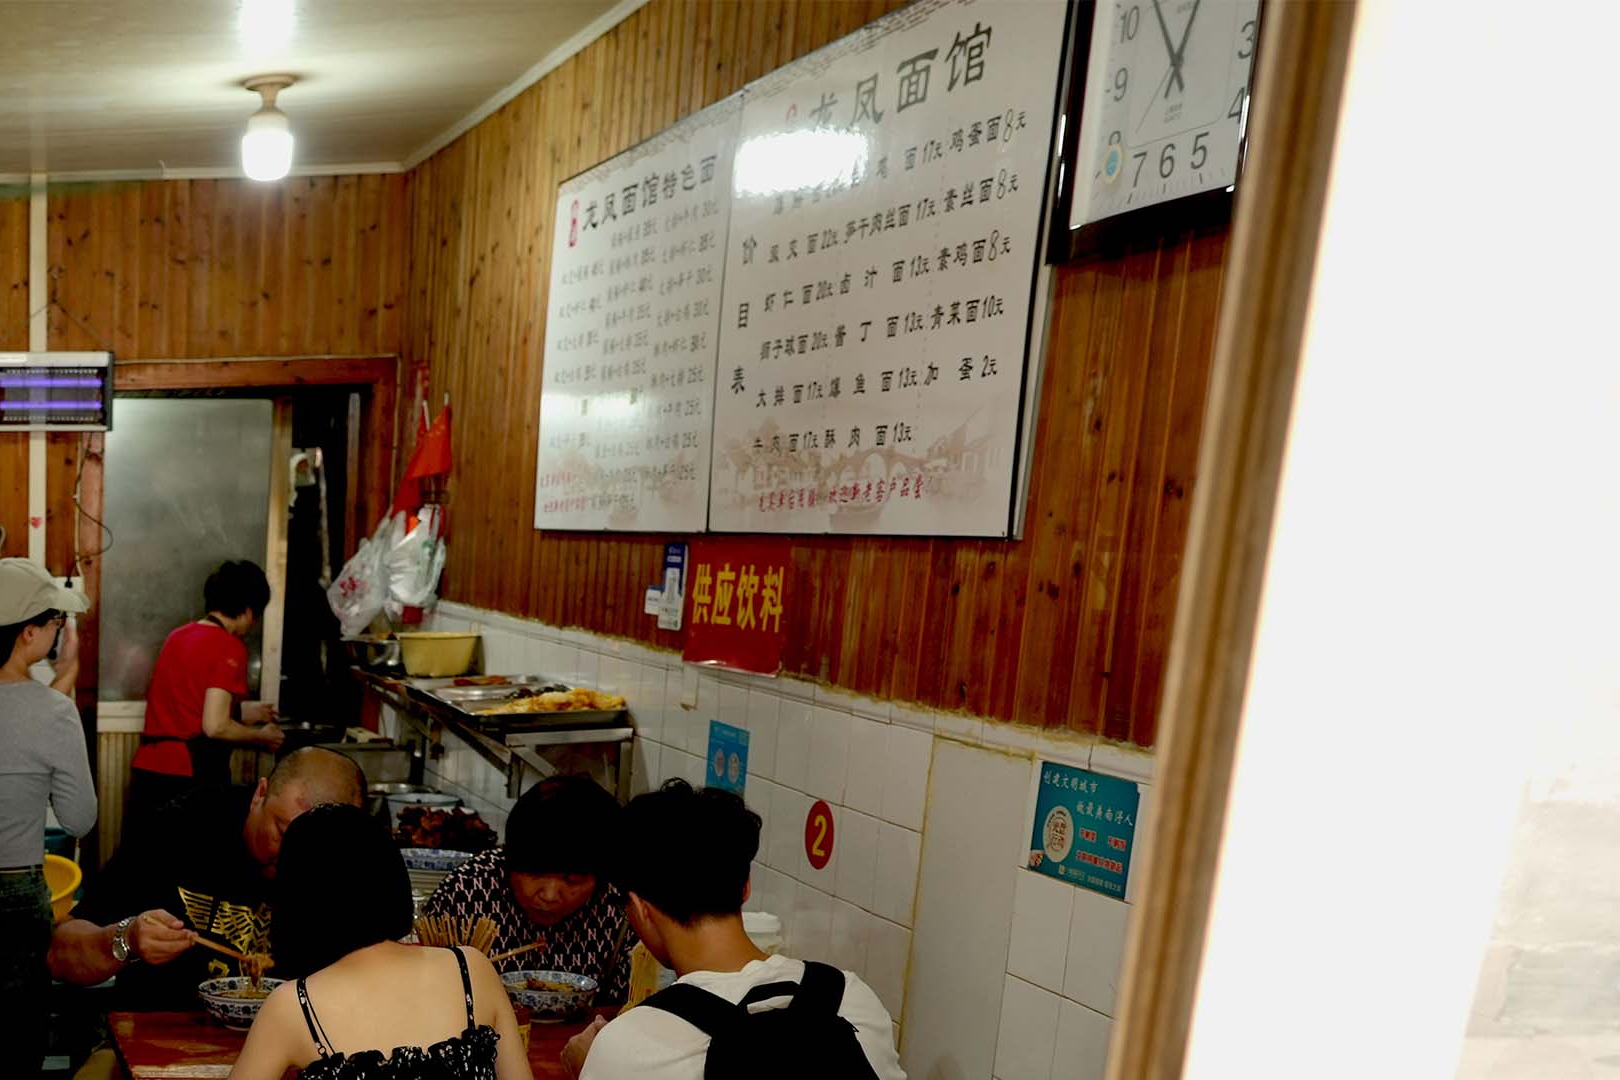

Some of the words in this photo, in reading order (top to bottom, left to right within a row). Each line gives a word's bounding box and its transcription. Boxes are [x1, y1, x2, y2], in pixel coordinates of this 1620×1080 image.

[1120, 5, 1140, 44] 10
[1113, 67, 1128, 102] 9
[1159, 143, 1175, 179] 6
[1190, 132, 1210, 169] 5
[1133, 151, 1148, 188] 7
[692, 563, 784, 633] 供应饮料
[812, 815, 827, 857] 2
